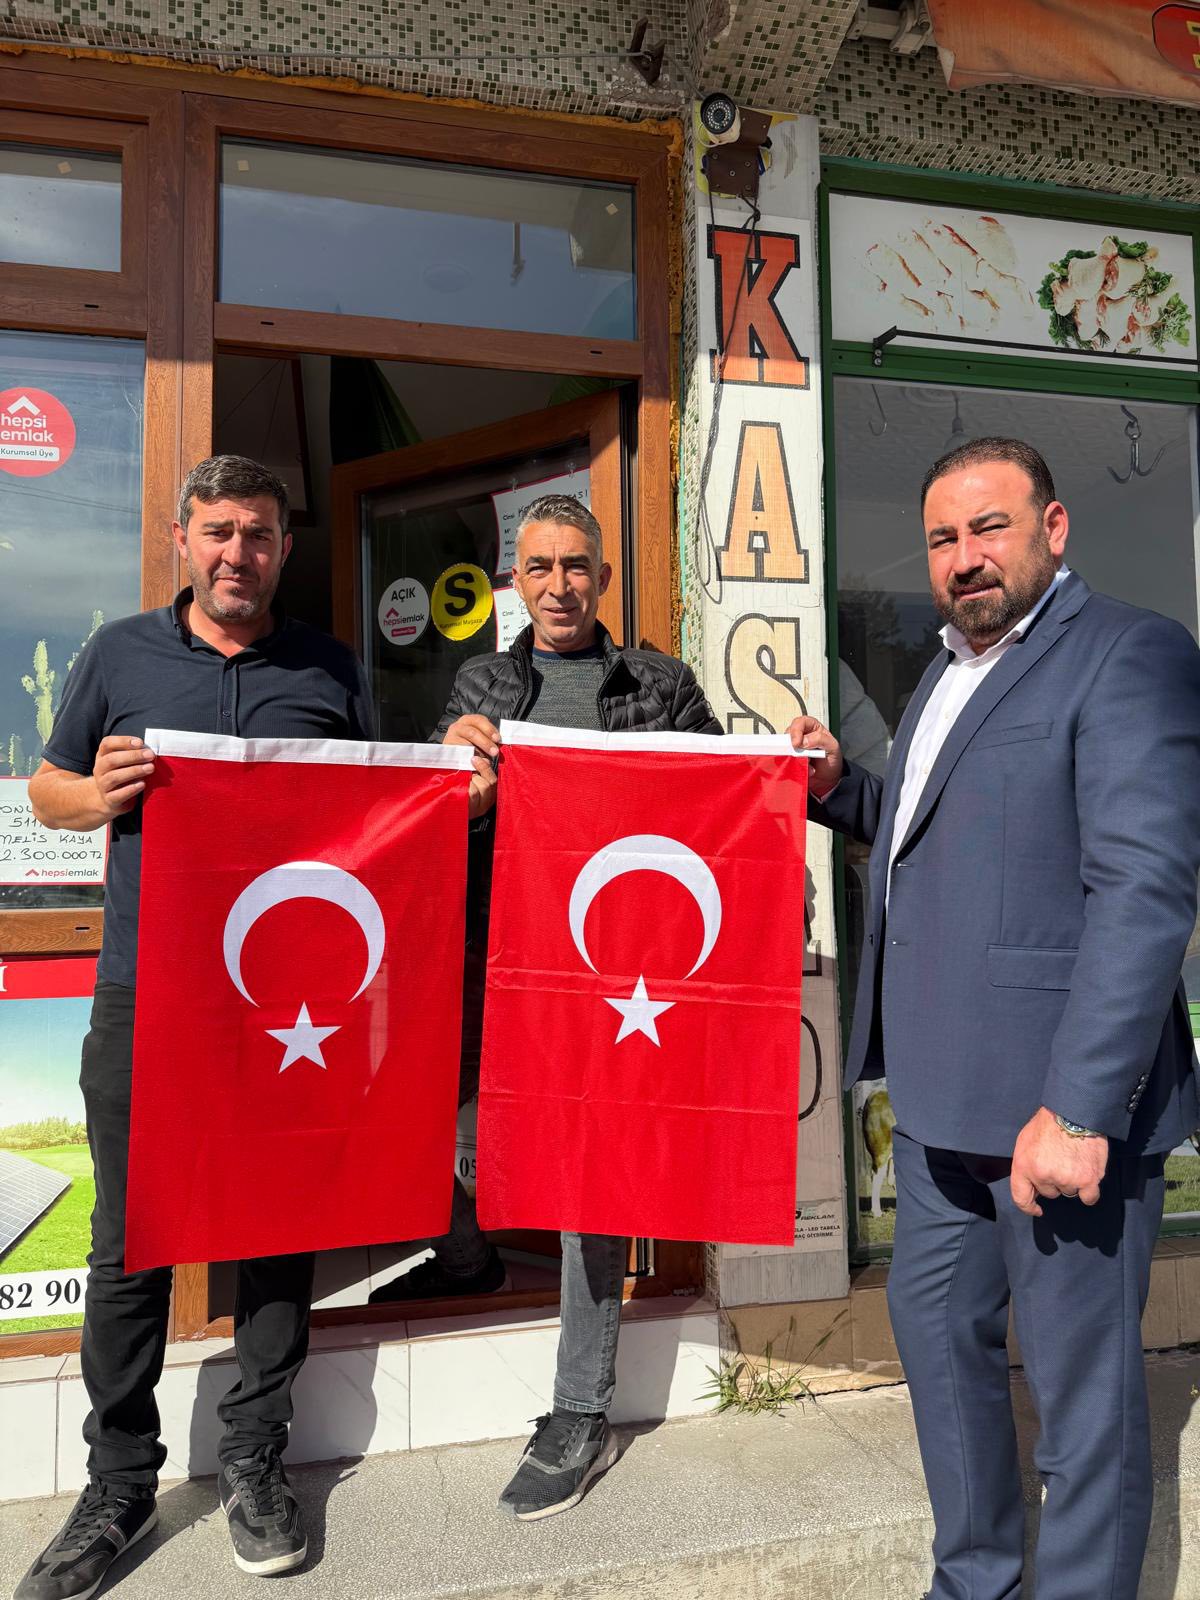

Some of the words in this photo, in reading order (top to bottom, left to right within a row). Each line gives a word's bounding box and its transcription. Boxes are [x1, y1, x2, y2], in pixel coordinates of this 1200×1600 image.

[1, 413, 47, 430] hepsi
[0, 429, 54, 442] emlak
[0, 448, 37, 456] Kurumsal
[39, 448, 54, 458] Üye
[391, 586, 416, 602] AÇIK
[445, 571, 475, 617] S
[383, 613, 425, 627] hepsiemlak
[60, 834, 93, 844] KAYA
[0, 847, 87, 861] 2.300.000
[41, 868, 99, 878] hepsiemlak
[0, 1283, 33, 1310] 82
[45, 1277, 81, 1307] 90
